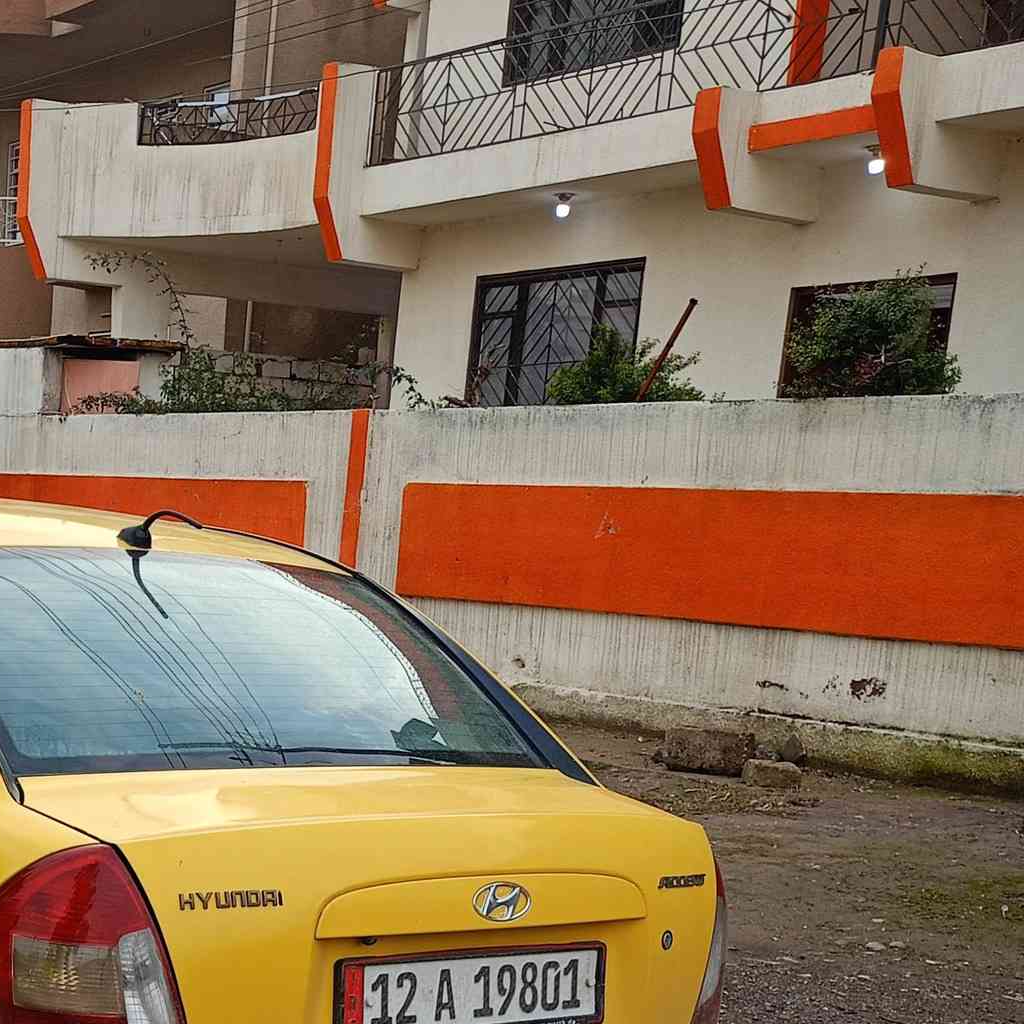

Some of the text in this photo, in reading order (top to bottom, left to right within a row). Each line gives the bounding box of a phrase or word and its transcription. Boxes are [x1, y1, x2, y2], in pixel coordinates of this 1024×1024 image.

[178, 889, 284, 911] HYUNDAI
[434, 968, 457, 1021] A
[473, 958, 581, 1018] 19801
